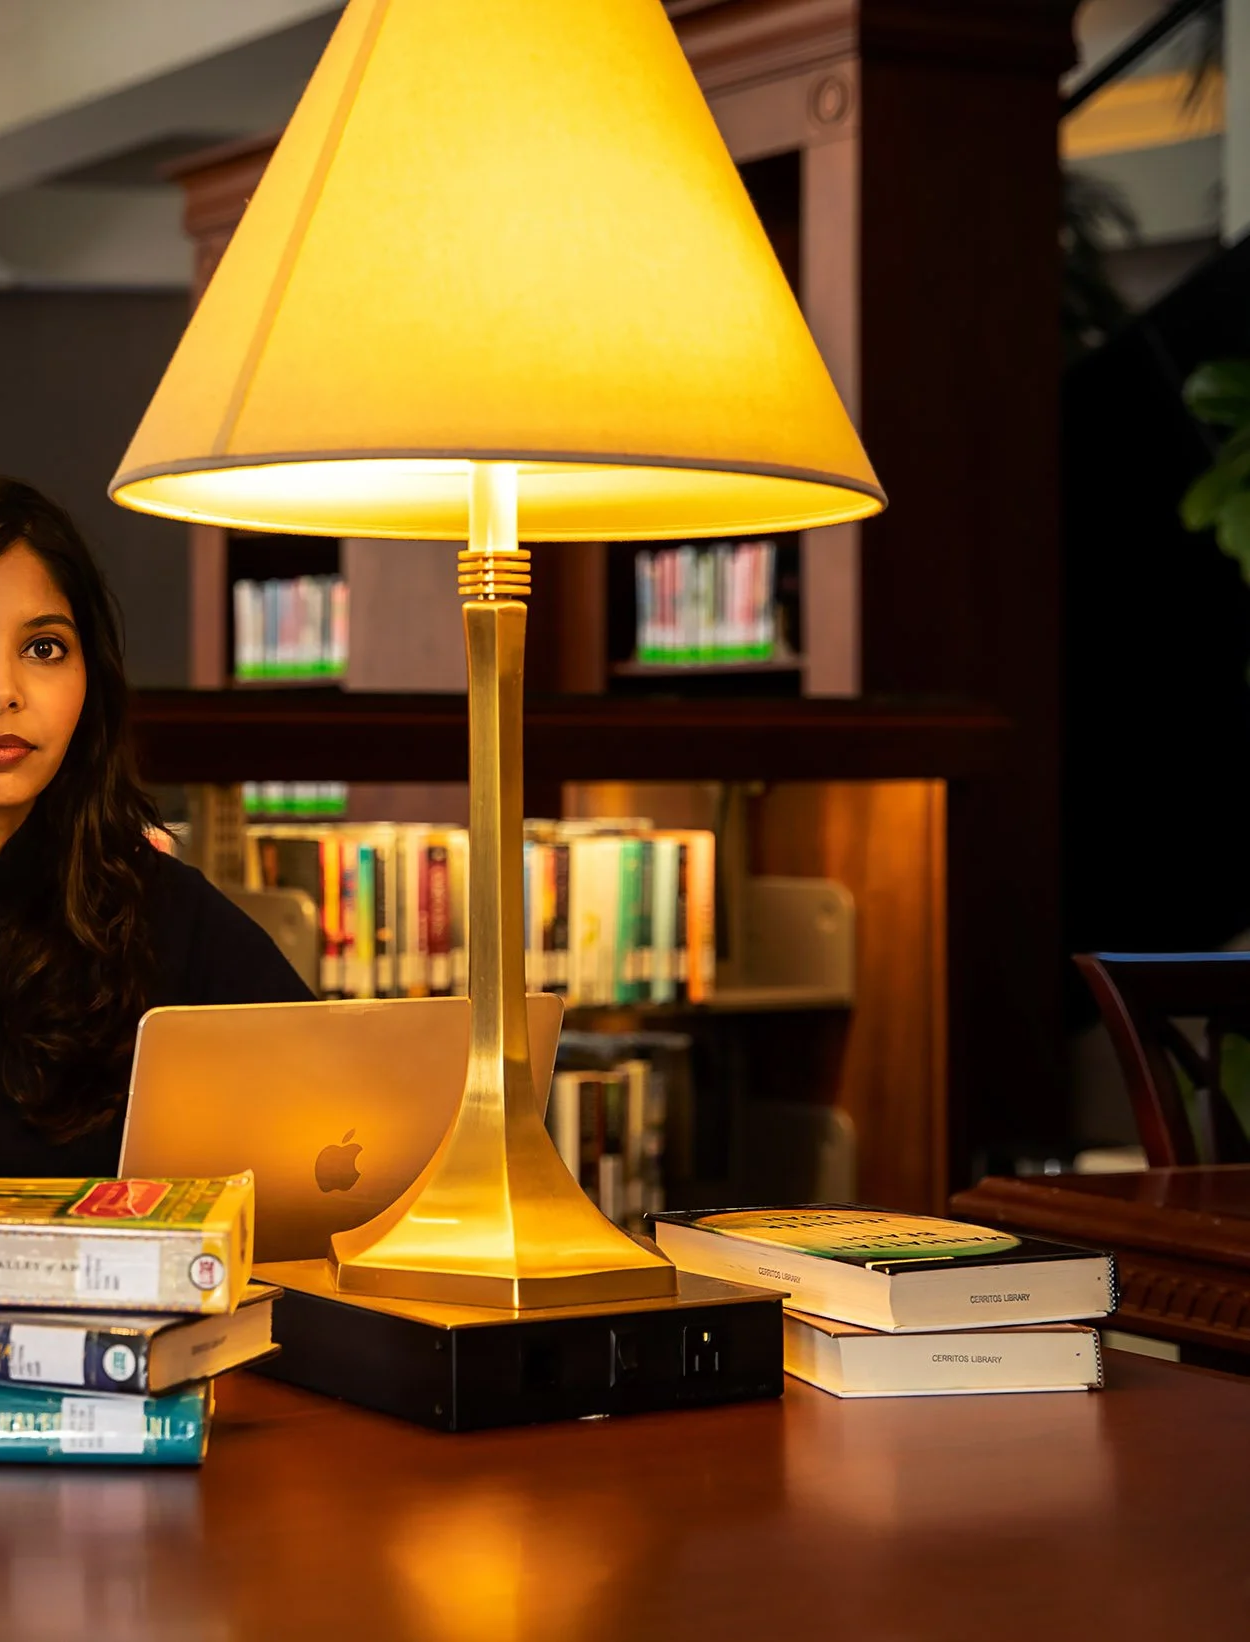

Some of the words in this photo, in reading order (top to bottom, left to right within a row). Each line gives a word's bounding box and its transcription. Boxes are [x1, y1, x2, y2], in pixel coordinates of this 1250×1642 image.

[758, 1267, 781, 1279] CERRITOS
[970, 1295, 1002, 1304] CERRITOS
[1003, 1293, 1030, 1302] LIBRARY
[931, 1354, 969, 1363] CERRITOS
[970, 1355, 1002, 1364] LIBRARY
